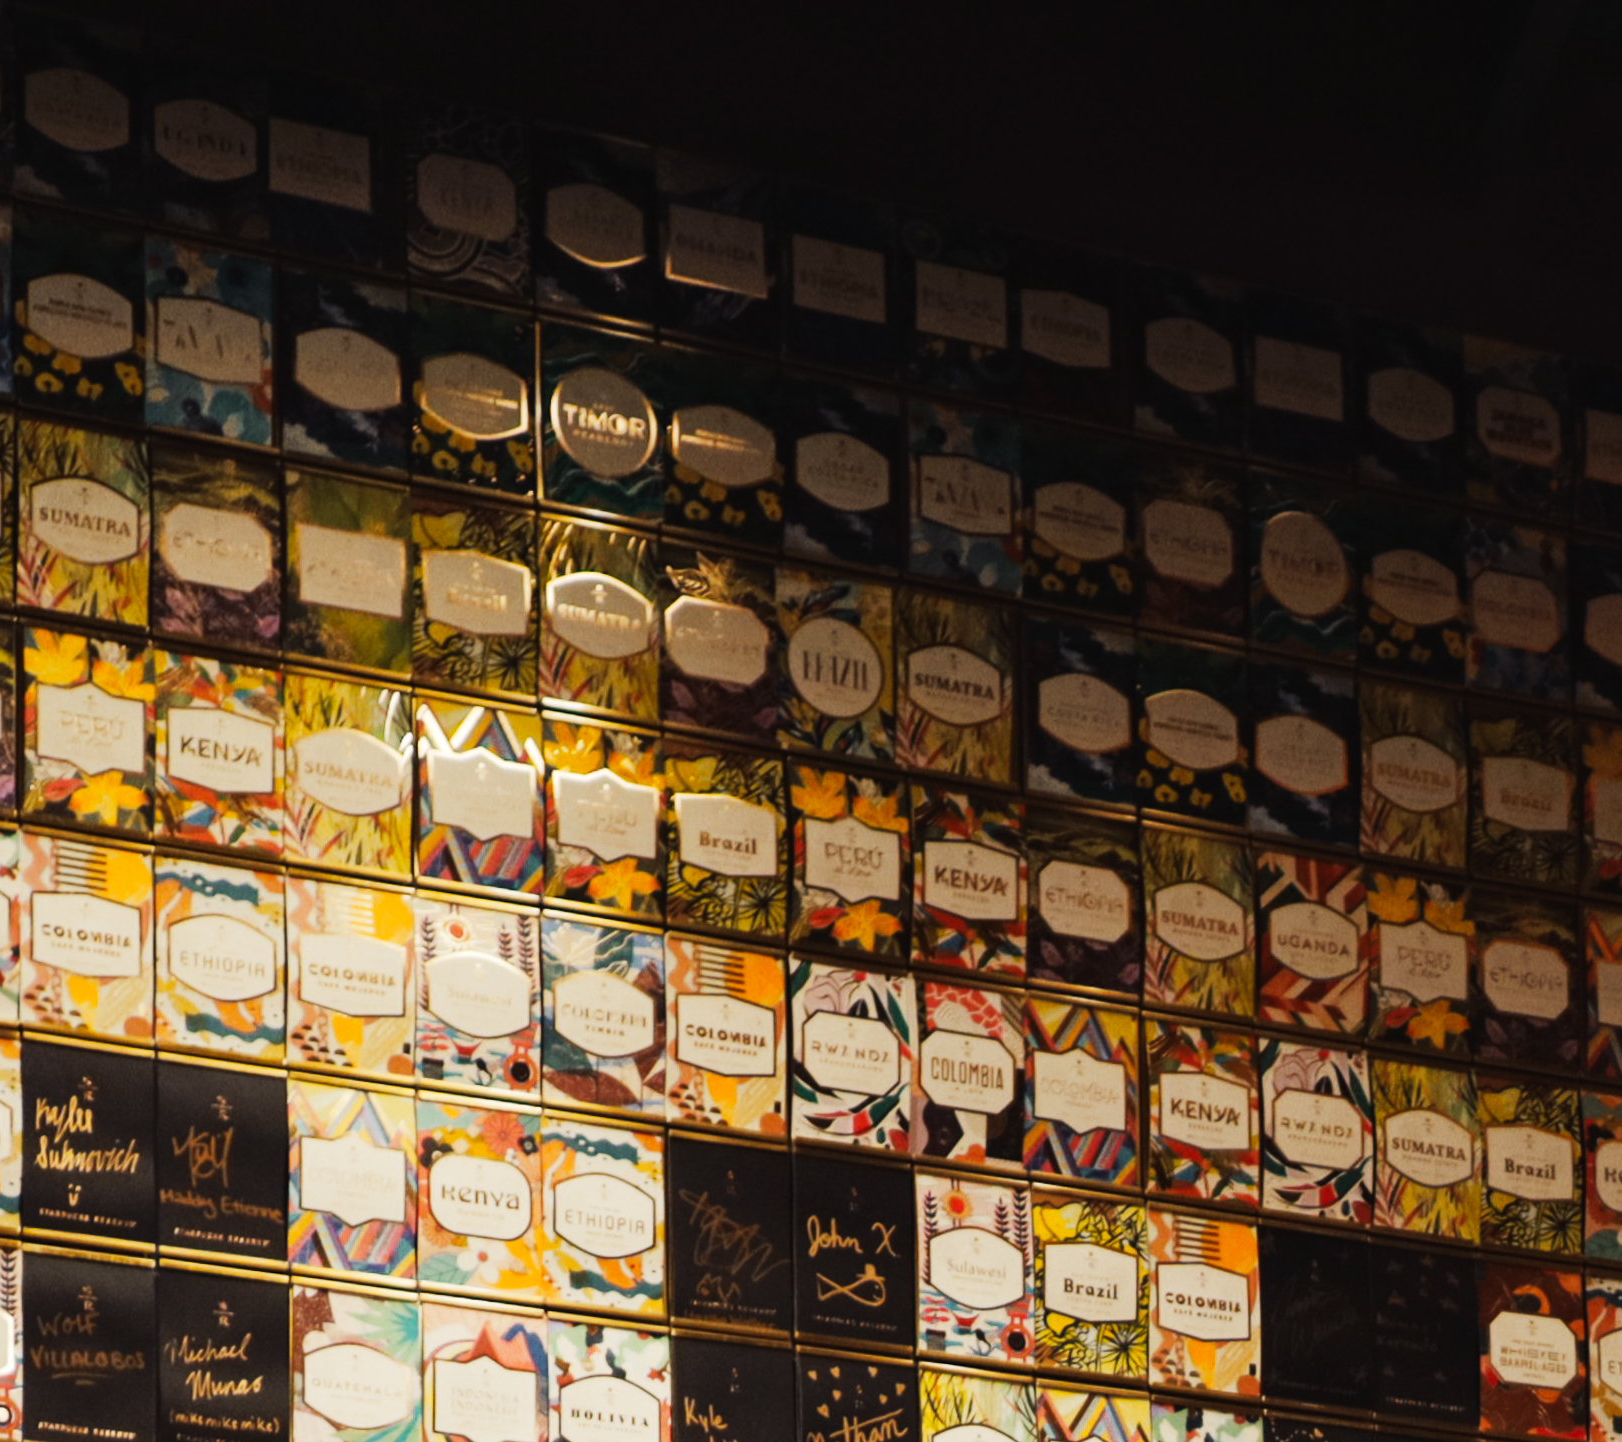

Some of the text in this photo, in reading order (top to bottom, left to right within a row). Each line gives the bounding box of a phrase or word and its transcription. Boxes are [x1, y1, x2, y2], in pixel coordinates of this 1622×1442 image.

[687, 1024, 765, 1050] COLOMBIA
[932, 1056, 1004, 1090] COLOMBIA
[1171, 1099, 1239, 1126] KENYA
[1392, 1138, 1466, 1161] SUMATRA
[807, 1215, 862, 1257] John
[1064, 1278, 1117, 1300] Brazil
